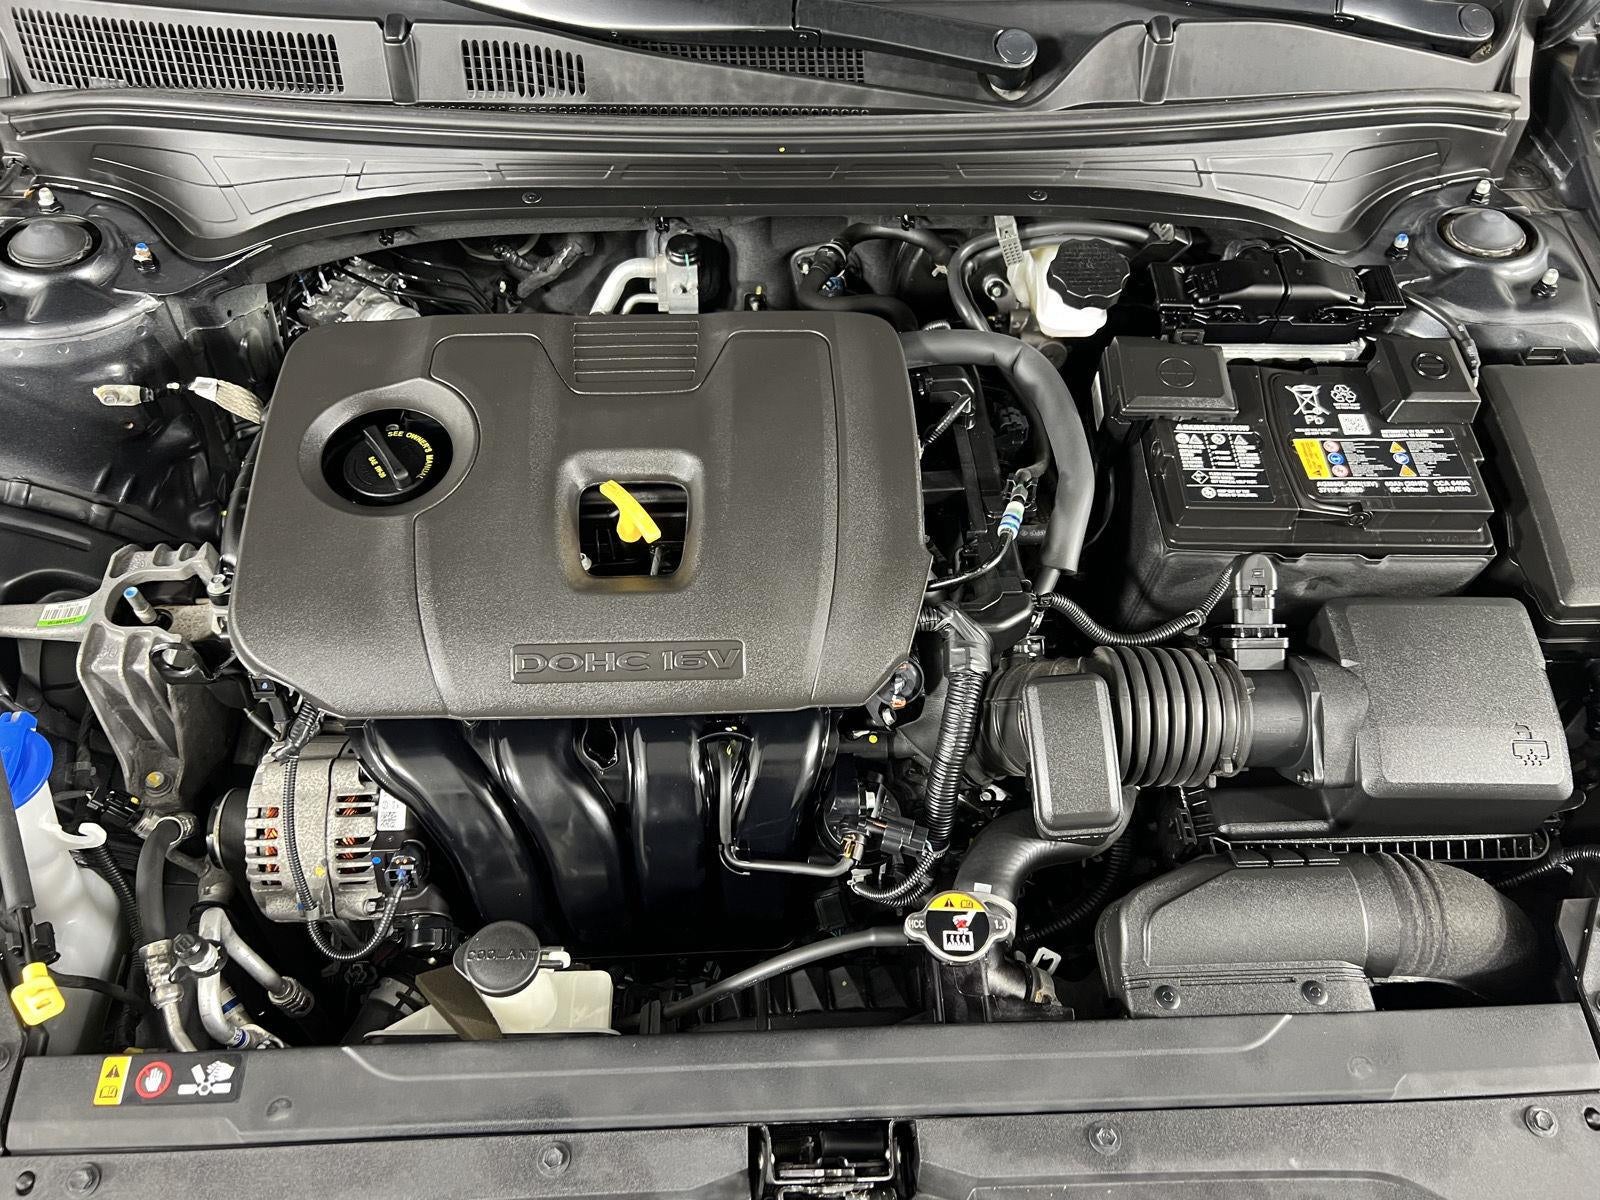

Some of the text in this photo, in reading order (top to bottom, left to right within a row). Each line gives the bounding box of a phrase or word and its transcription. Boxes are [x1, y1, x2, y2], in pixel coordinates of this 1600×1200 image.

[416, 454, 434, 479] MANUAL
[514, 649, 741, 674] DOHC 16V
[908, 919, 925, 929] HCC
[994, 919, 1007, 930] 1.1
[467, 949, 538, 962] COOLANT
